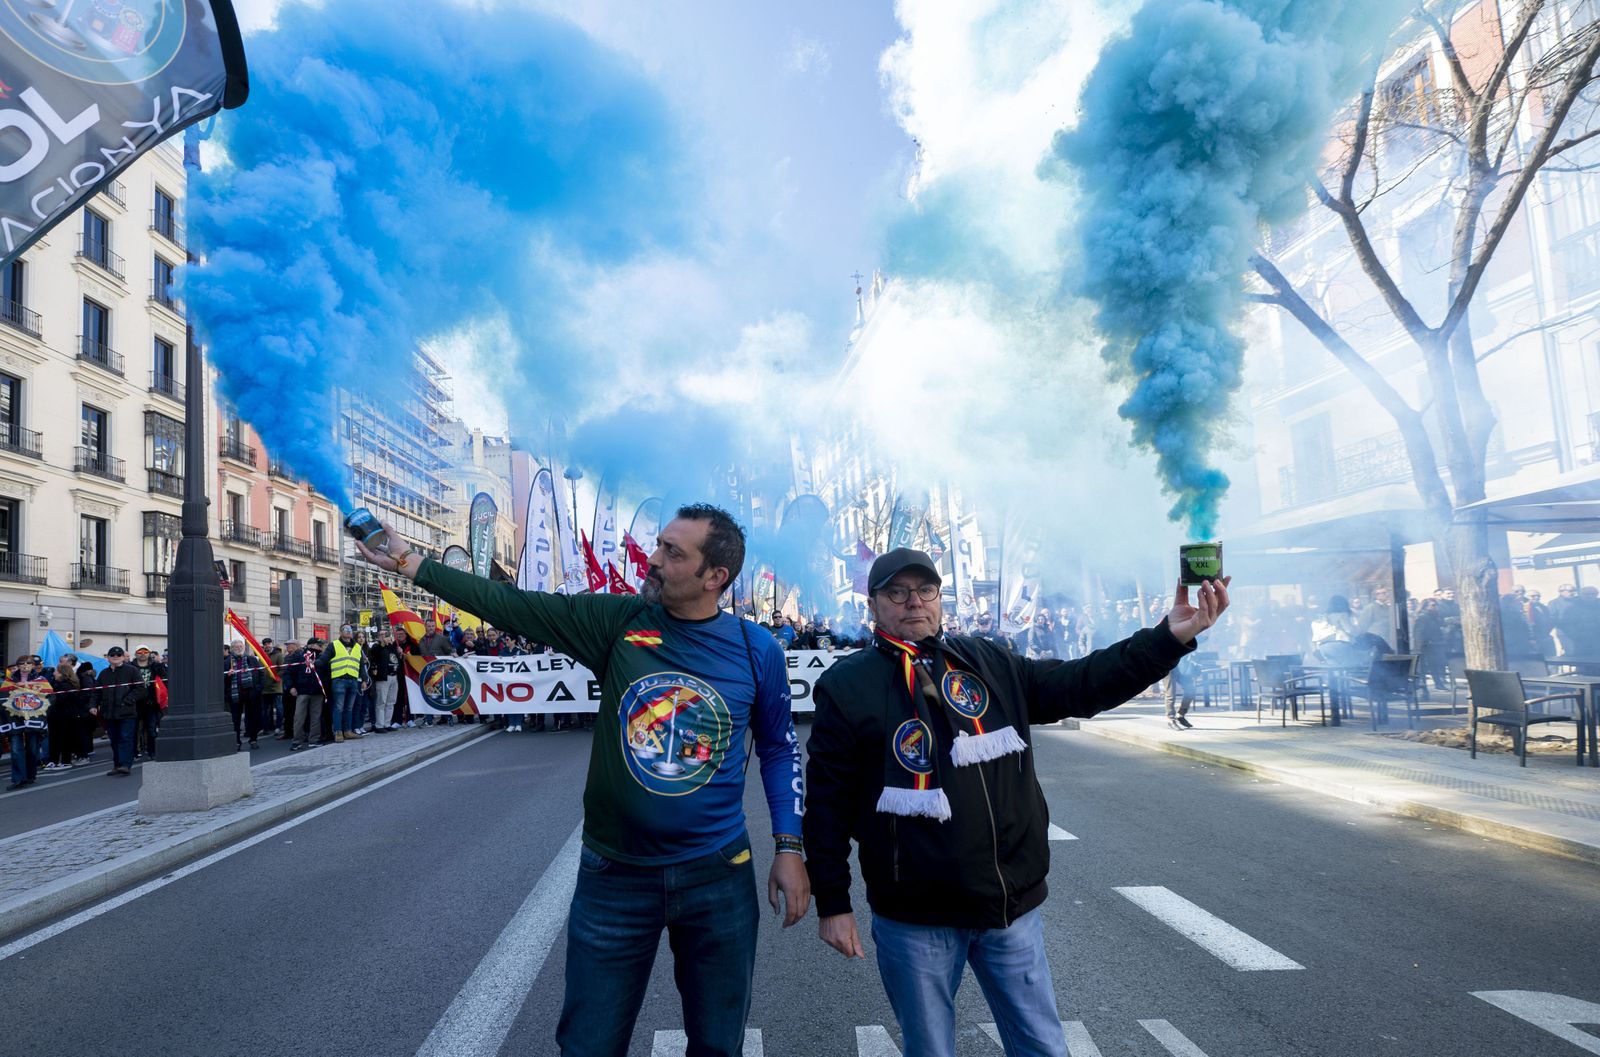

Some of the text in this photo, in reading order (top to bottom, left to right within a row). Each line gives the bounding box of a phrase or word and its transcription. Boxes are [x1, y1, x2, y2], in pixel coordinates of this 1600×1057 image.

[473, 511, 495, 521] JUCIL
[478, 525, 490, 577] JUCIL
[476, 660, 531, 673] ESTA
[537, 658, 577, 672] LEY
[481, 682, 535, 703] NO
[638, 677, 718, 707] JUSAPOL
